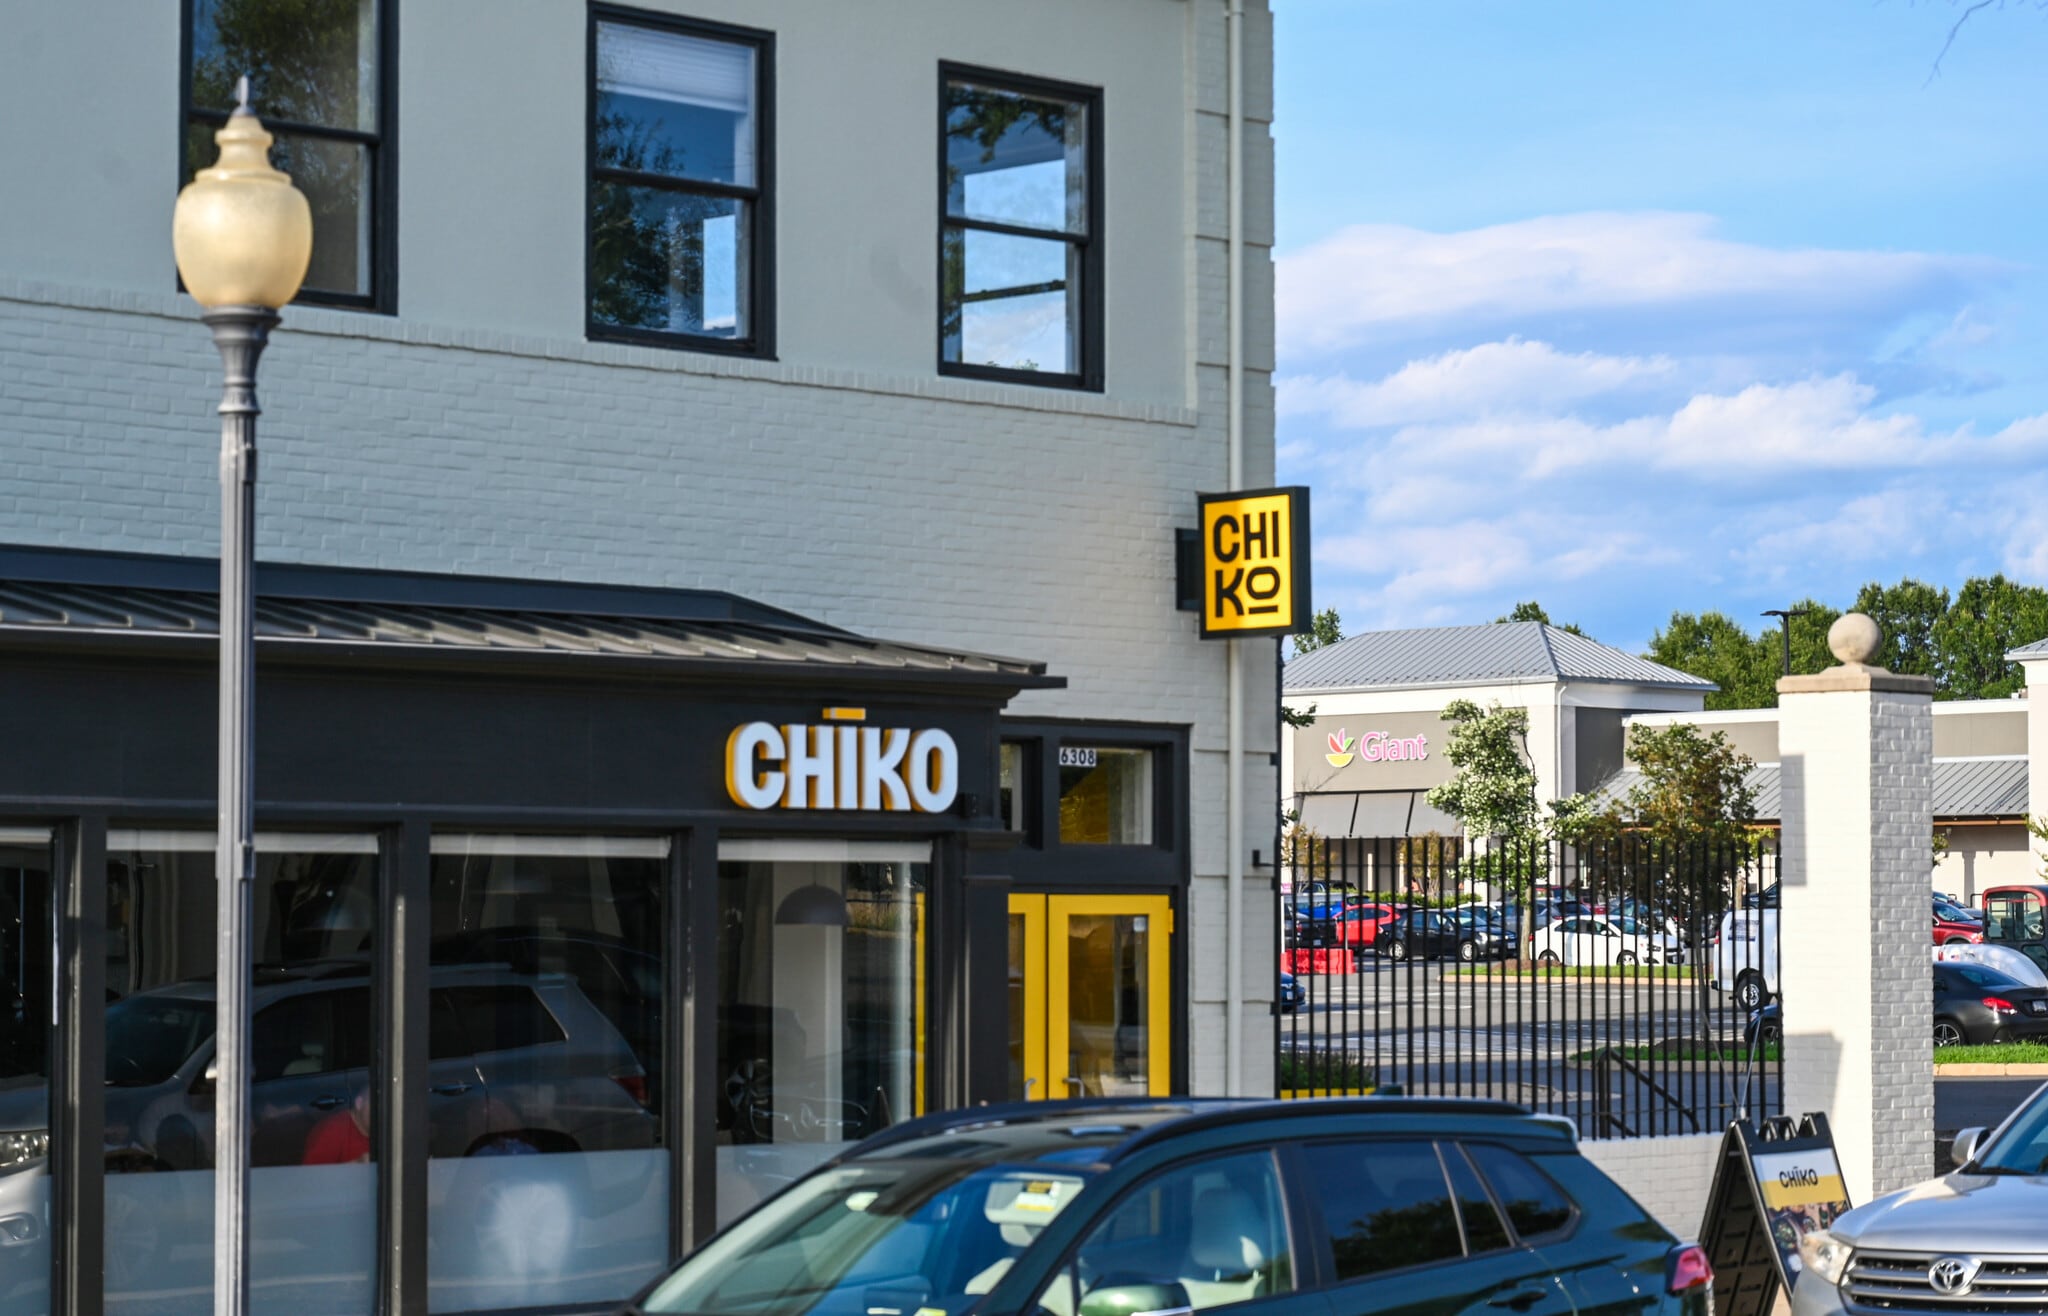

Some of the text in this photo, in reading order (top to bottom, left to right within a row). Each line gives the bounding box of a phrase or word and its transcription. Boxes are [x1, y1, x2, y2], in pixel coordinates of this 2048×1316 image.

[1213, 511, 1280, 563] CHI
[1061, 748, 1095, 765] 6308
[1360, 731, 1428, 762] Giant
